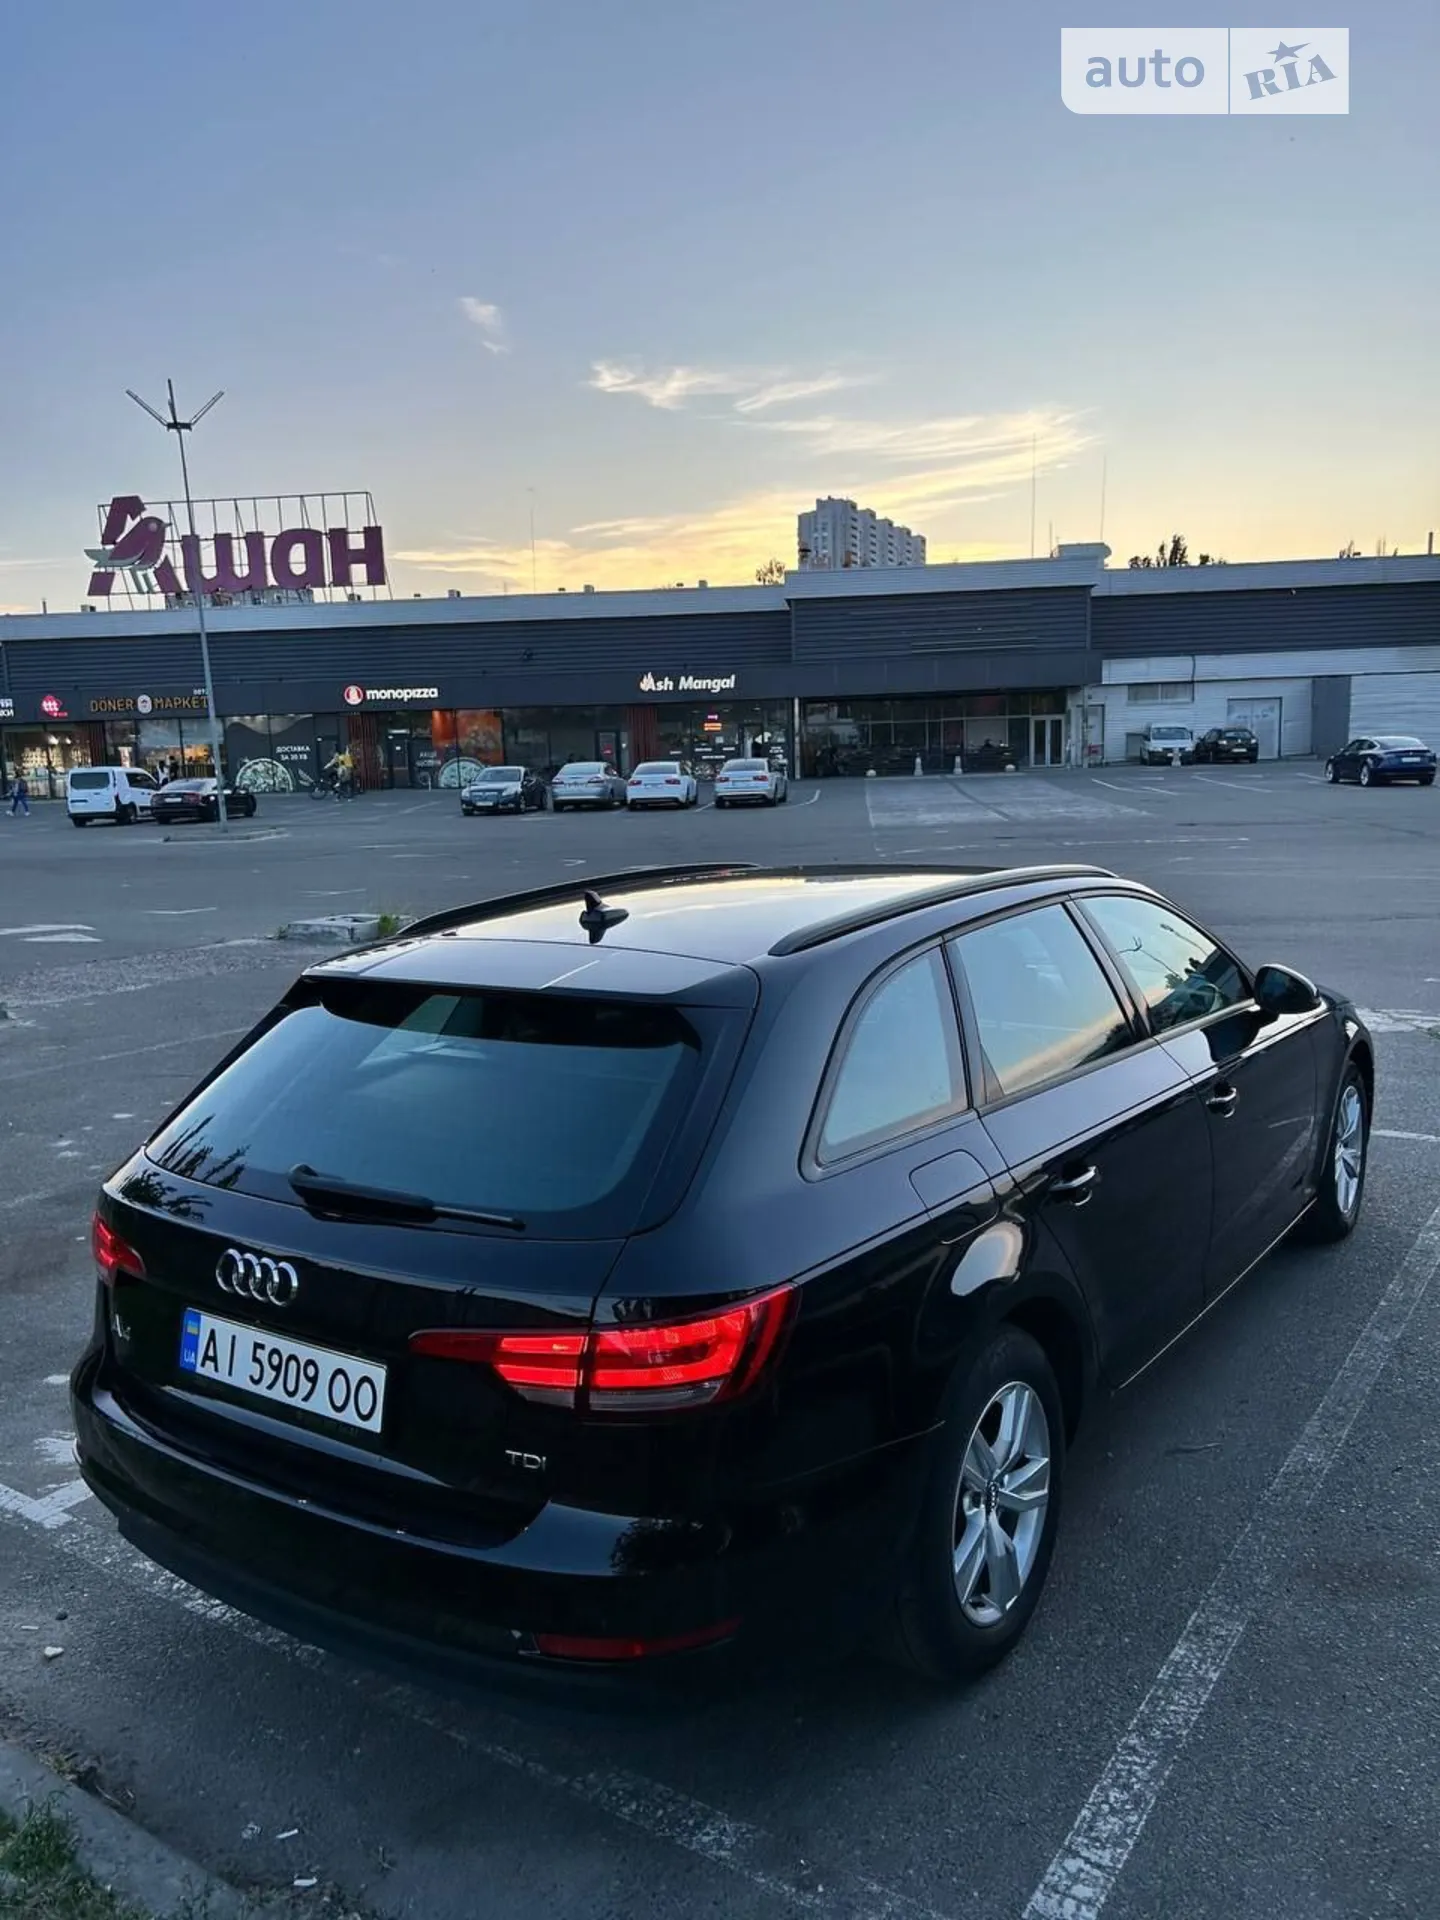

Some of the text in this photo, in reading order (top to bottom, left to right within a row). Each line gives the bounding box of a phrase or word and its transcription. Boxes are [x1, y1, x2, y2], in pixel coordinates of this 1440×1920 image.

[640, 672, 736, 693] Ash Mangal
[90, 697, 134, 712] DÖNER
[366, 688, 439, 702] monopizza
[183, 1348, 196, 1365] UA
[200, 1328, 378, 1422] AI 5909 OO
[505, 1450, 547, 1471] TDI
